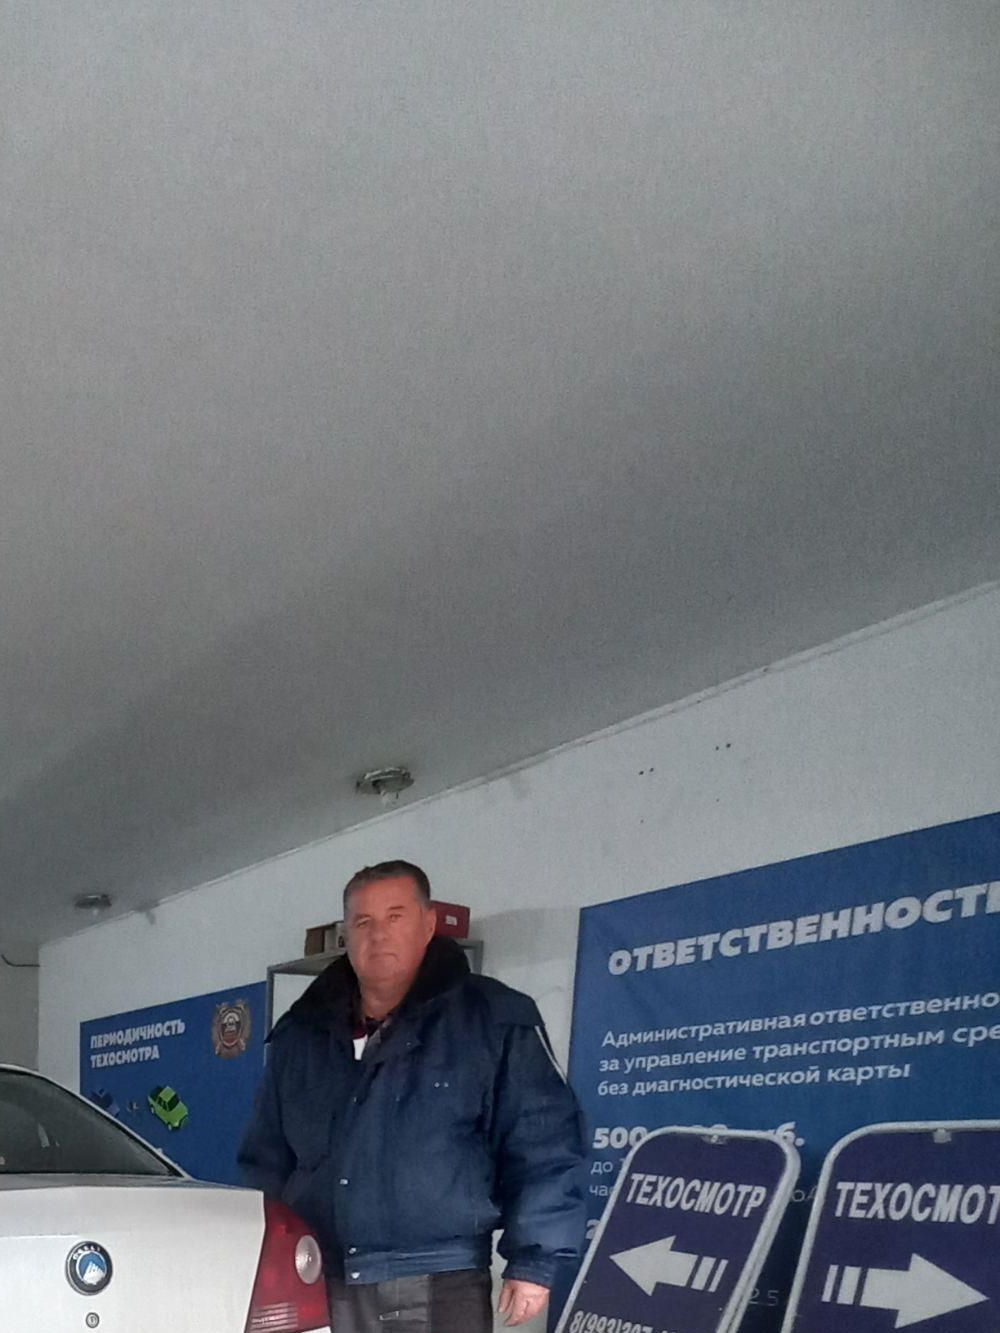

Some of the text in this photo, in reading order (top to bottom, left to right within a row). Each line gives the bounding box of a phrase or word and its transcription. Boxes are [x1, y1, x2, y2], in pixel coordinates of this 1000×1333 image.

[90, 1018, 186, 1049] ПЕРИОДИЧНОСТЬ
[602, 1012, 806, 1048] Административная
[90, 1044, 160, 1069] ТЕХОСМОТРА
[599, 1057, 620, 1073] за
[624, 1045, 747, 1072] управление
[753, 1028, 945, 1058] транспортным
[597, 1063, 911, 1097] без диагностической карты
[591, 1161, 613, 1175] до
[626, 1173, 767, 1218] ТЕХОСМОТР
